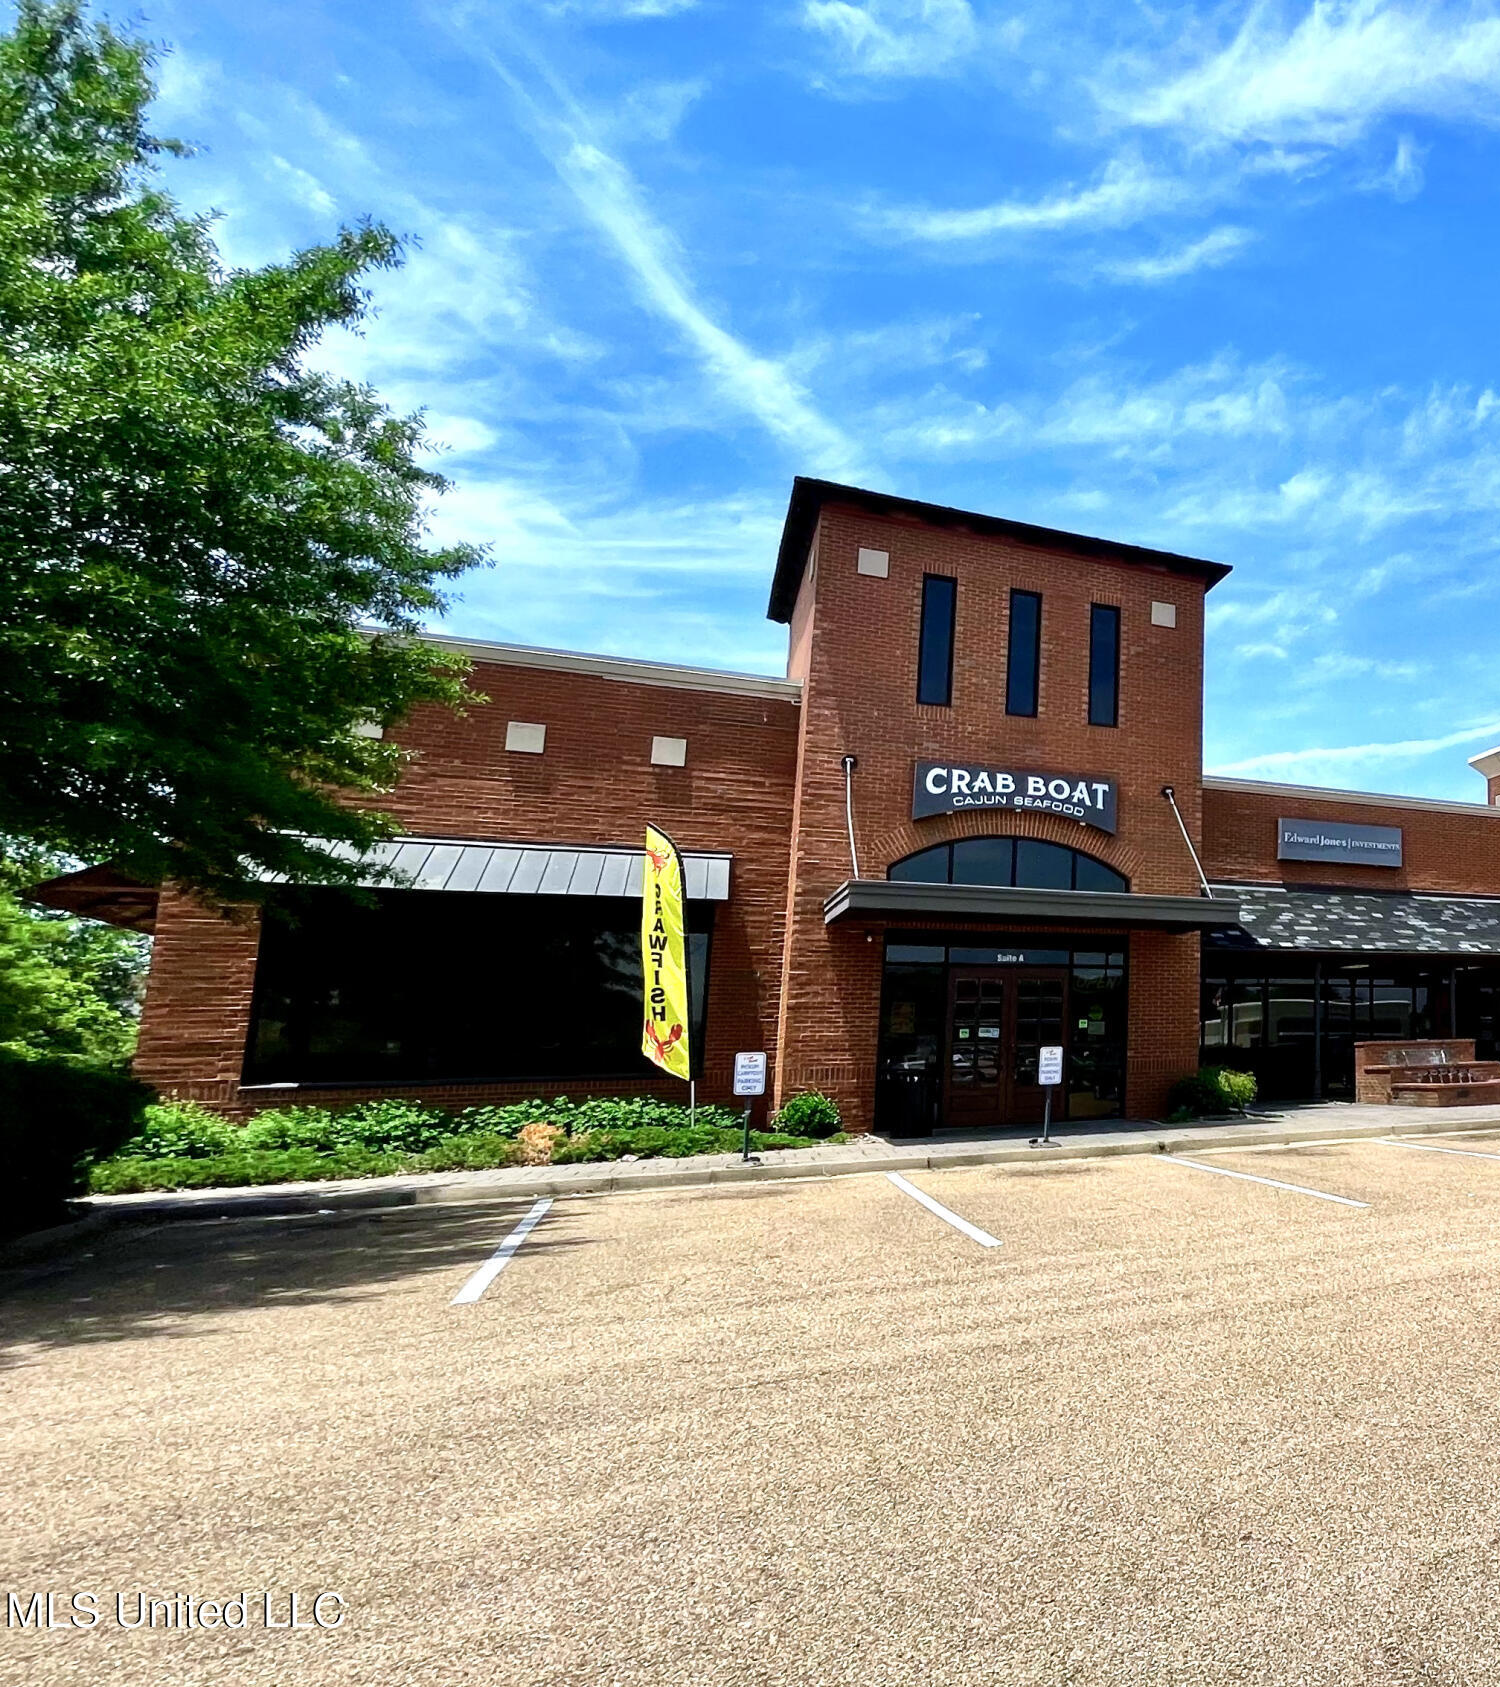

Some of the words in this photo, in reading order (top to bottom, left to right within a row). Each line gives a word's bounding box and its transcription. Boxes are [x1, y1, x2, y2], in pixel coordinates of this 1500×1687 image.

[925, 767, 1016, 795] CRAB
[1027, 775, 1110, 810] BOAT
[952, 795, 1007, 806] CAJUN
[1013, 796, 1085, 817] SEAFOOD
[1351, 840, 1400, 851] INVESTMENTS
[997, 953, 1017, 962] Suite
[1018, 953, 1024, 962] A
